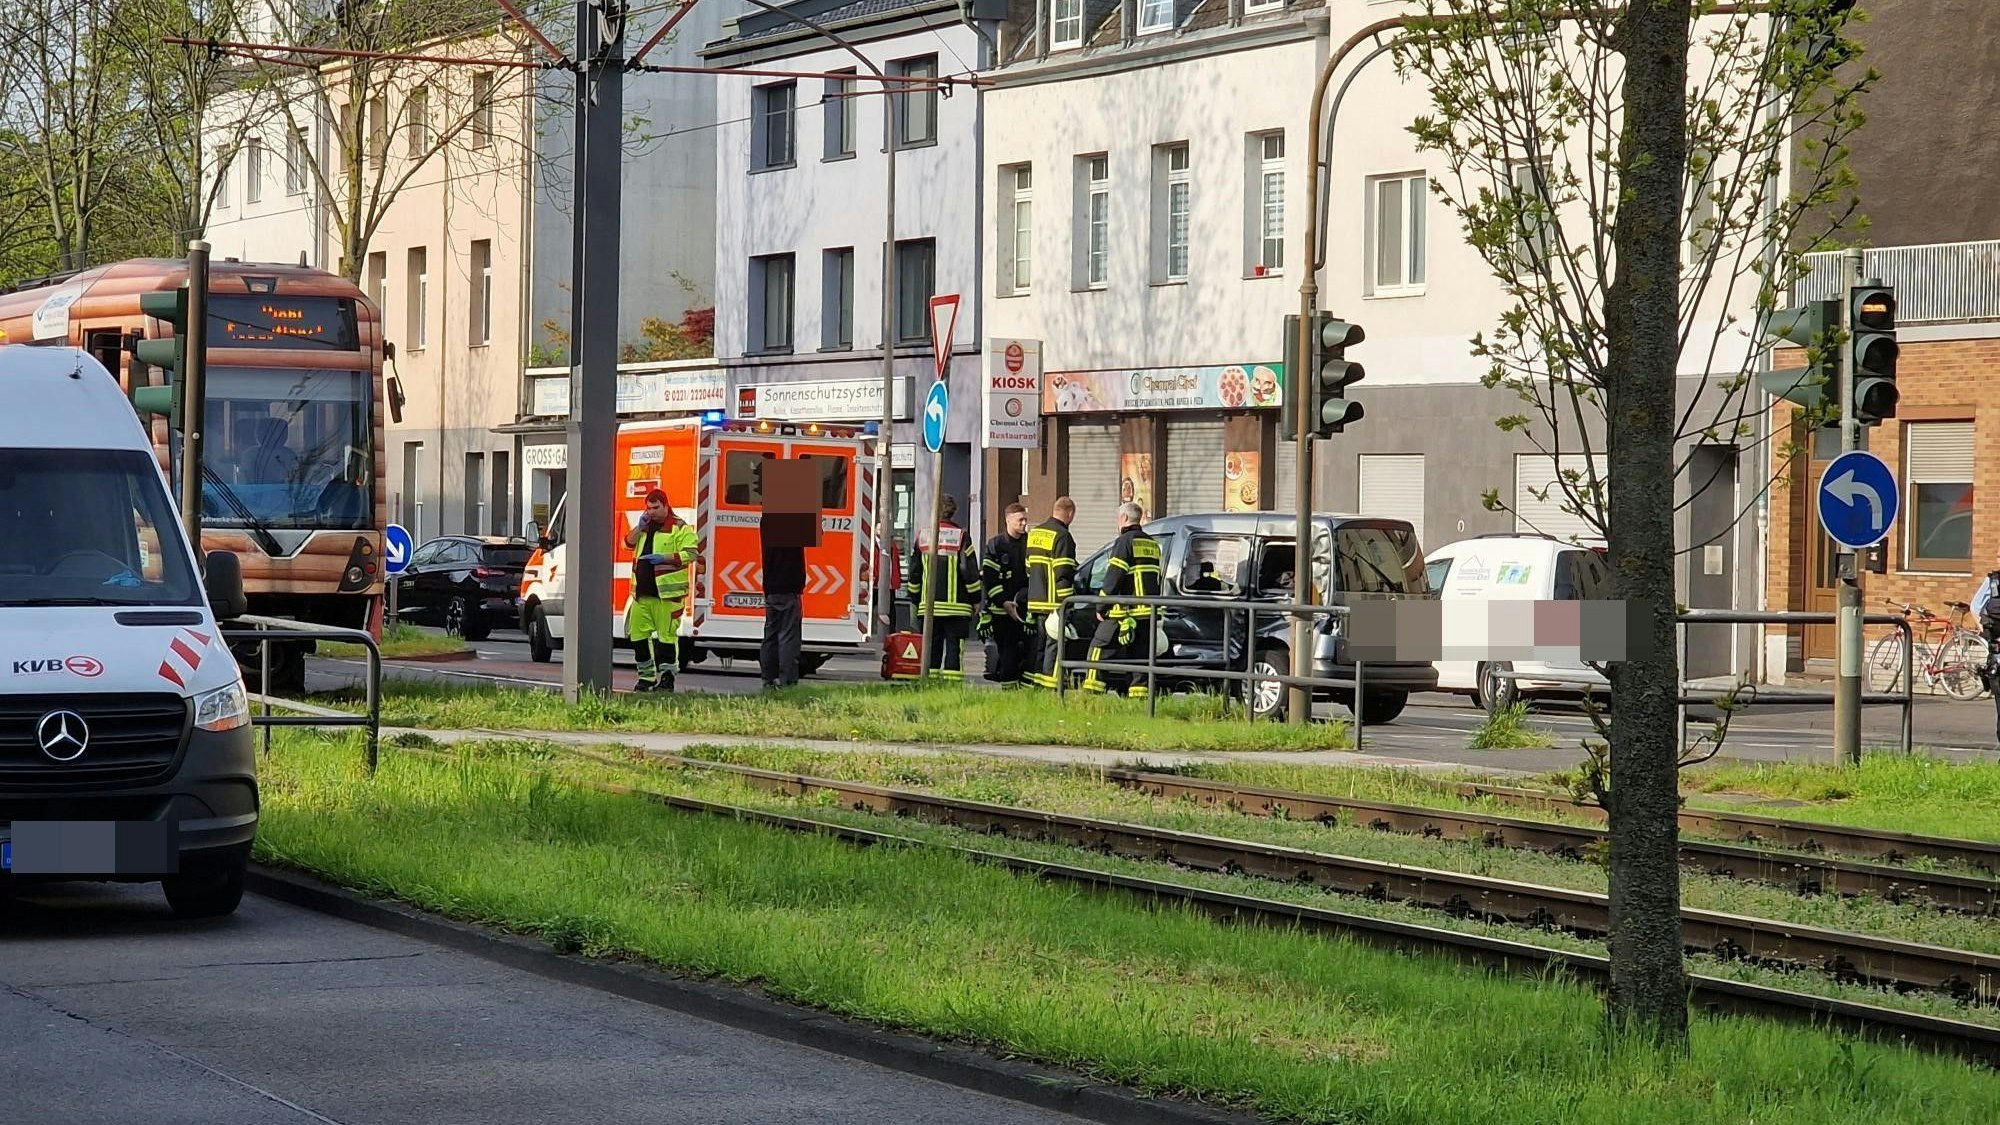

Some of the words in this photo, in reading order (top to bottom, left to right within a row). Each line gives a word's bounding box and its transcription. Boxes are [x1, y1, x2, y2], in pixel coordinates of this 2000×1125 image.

[992, 377, 1036, 389] KIOSK
[989, 431, 1037, 441] Restaurant
[831, 517, 852, 530] 112
[12, 659, 63, 674] KVB
